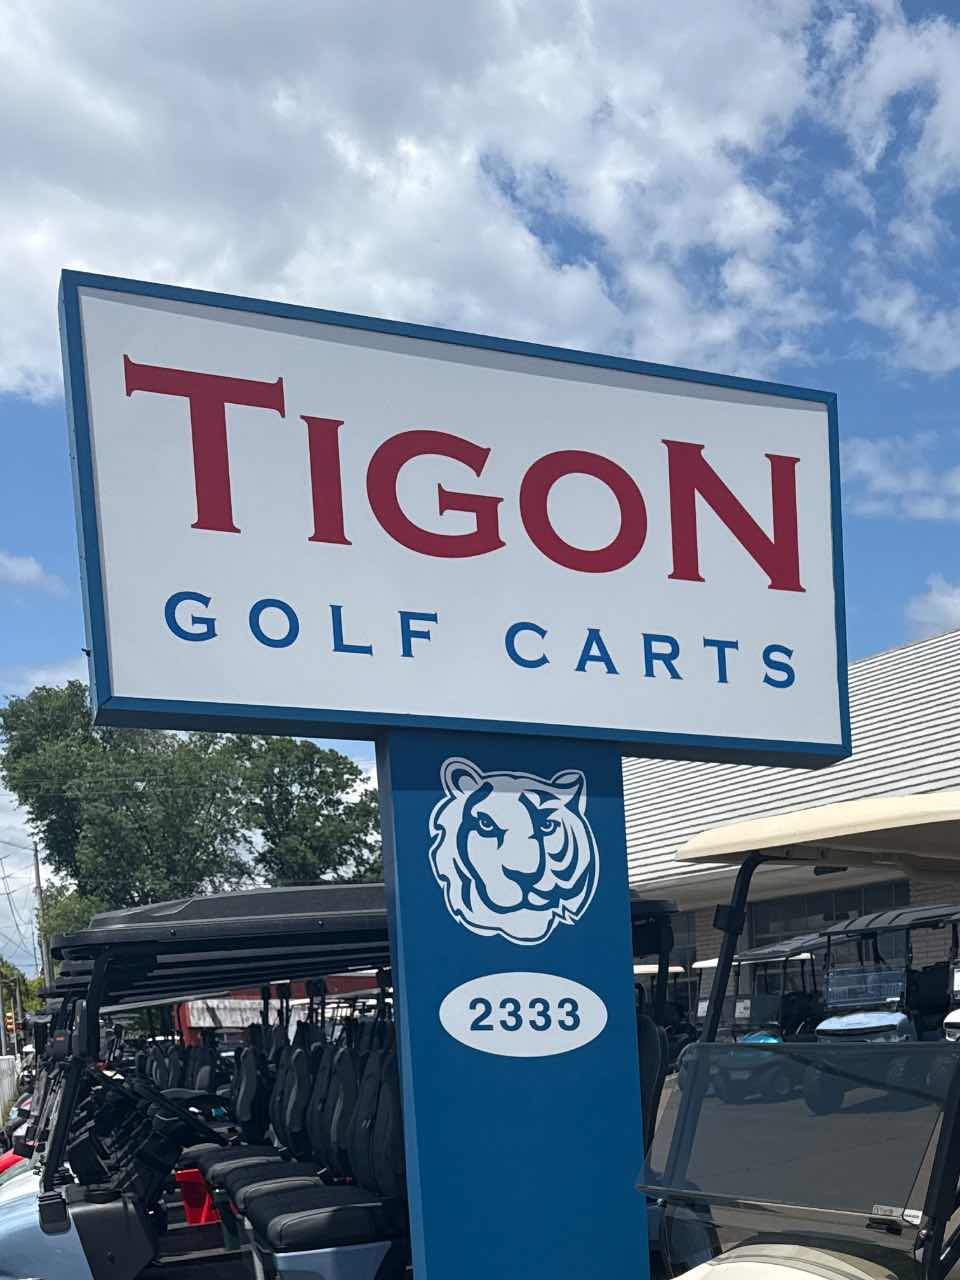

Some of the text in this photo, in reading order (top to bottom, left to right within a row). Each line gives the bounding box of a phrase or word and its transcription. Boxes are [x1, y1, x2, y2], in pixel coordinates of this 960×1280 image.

[123, 354, 806, 593] TIGON
[163, 590, 798, 690] GOLF CARTS
[468, 996, 581, 1032] 2333
